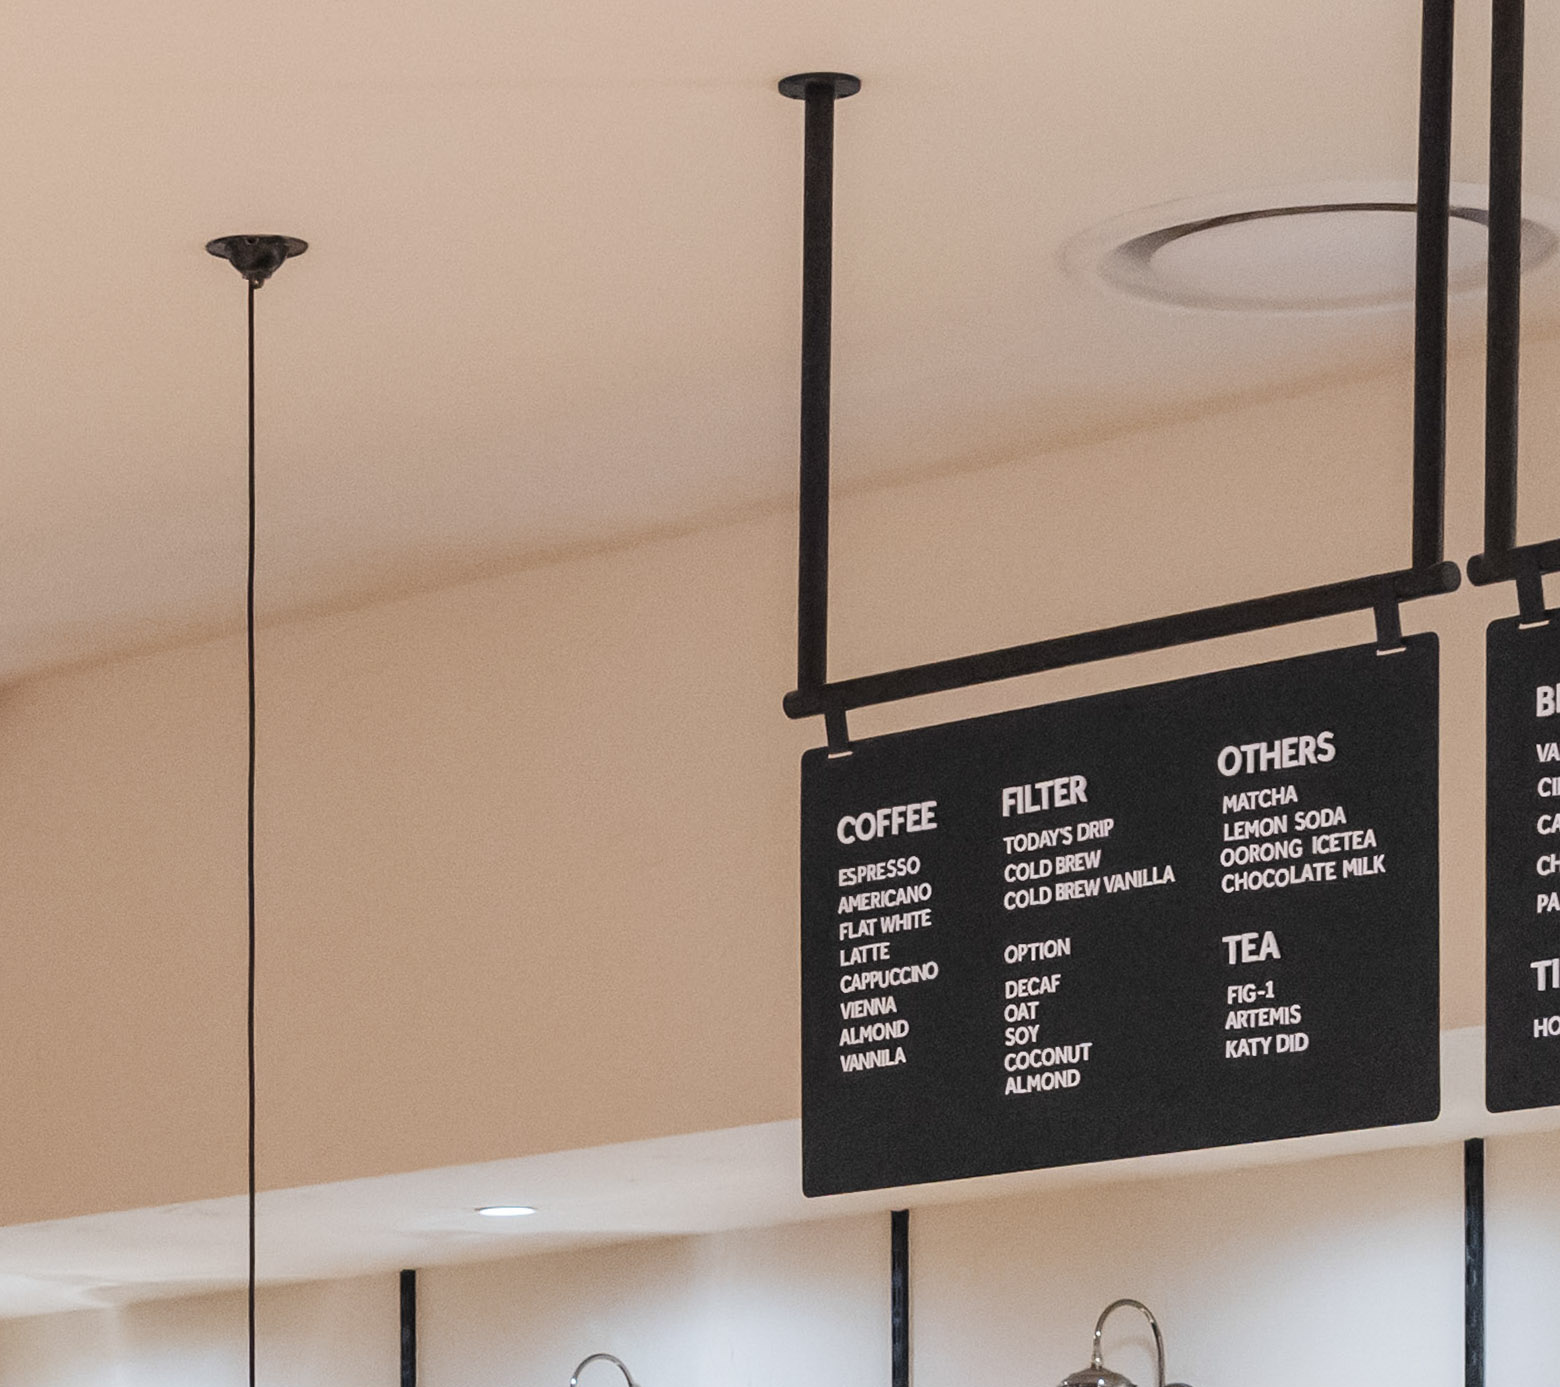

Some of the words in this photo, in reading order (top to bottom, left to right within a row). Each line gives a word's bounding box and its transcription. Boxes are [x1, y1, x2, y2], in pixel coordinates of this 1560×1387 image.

[1217, 730, 1336, 777] OTHERS
[1002, 774, 1088, 817] FILTER
[1222, 784, 1299, 815] MATCHA
[836, 800, 938, 845] COFFEE
[1002, 825, 1073, 855] TODAY'S
[1076, 818, 1115, 842] DRIP
[1223, 814, 1288, 842] LEMON
[1294, 805, 1347, 831] SODA
[838, 855, 921, 887] ESPRESSO
[1003, 858, 1053, 883] COLD
[1055, 849, 1102, 875] BREW
[1221, 861, 1338, 894] CHOCOLATE
[1342, 853, 1386, 879] MILK
[837, 882, 932, 915] AMERICANO
[1003, 885, 1053, 911] COLD
[1055, 877, 1101, 902] BREW
[1102, 864, 1176, 894] VANILLA
[839, 918, 878, 942] FLAT
[879, 908, 932, 934] WHITE
[839, 941, 891, 967] LATTE
[1003, 937, 1071, 964] OPTION
[1221, 930, 1282, 965] TEA
[839, 960, 939, 994] CAPPUCCINO
[1004, 973, 1062, 1000] DECAF
[1227, 980, 1275, 1005] FIG-1
[839, 995, 898, 1020] VIENNA
[1003, 1000, 1040, 1023] OAT
[1224, 1003, 1302, 1030] ARTEMIS
[838, 1019, 910, 1047] ALMOND
[1004, 1024, 1040, 1047] SOY
[1225, 1036, 1273, 1059] KATY
[1275, 1032, 1310, 1054] DID
[1003, 1042, 1093, 1072] COCONUT
[1004, 1068, 1081, 1096] ALMOND
